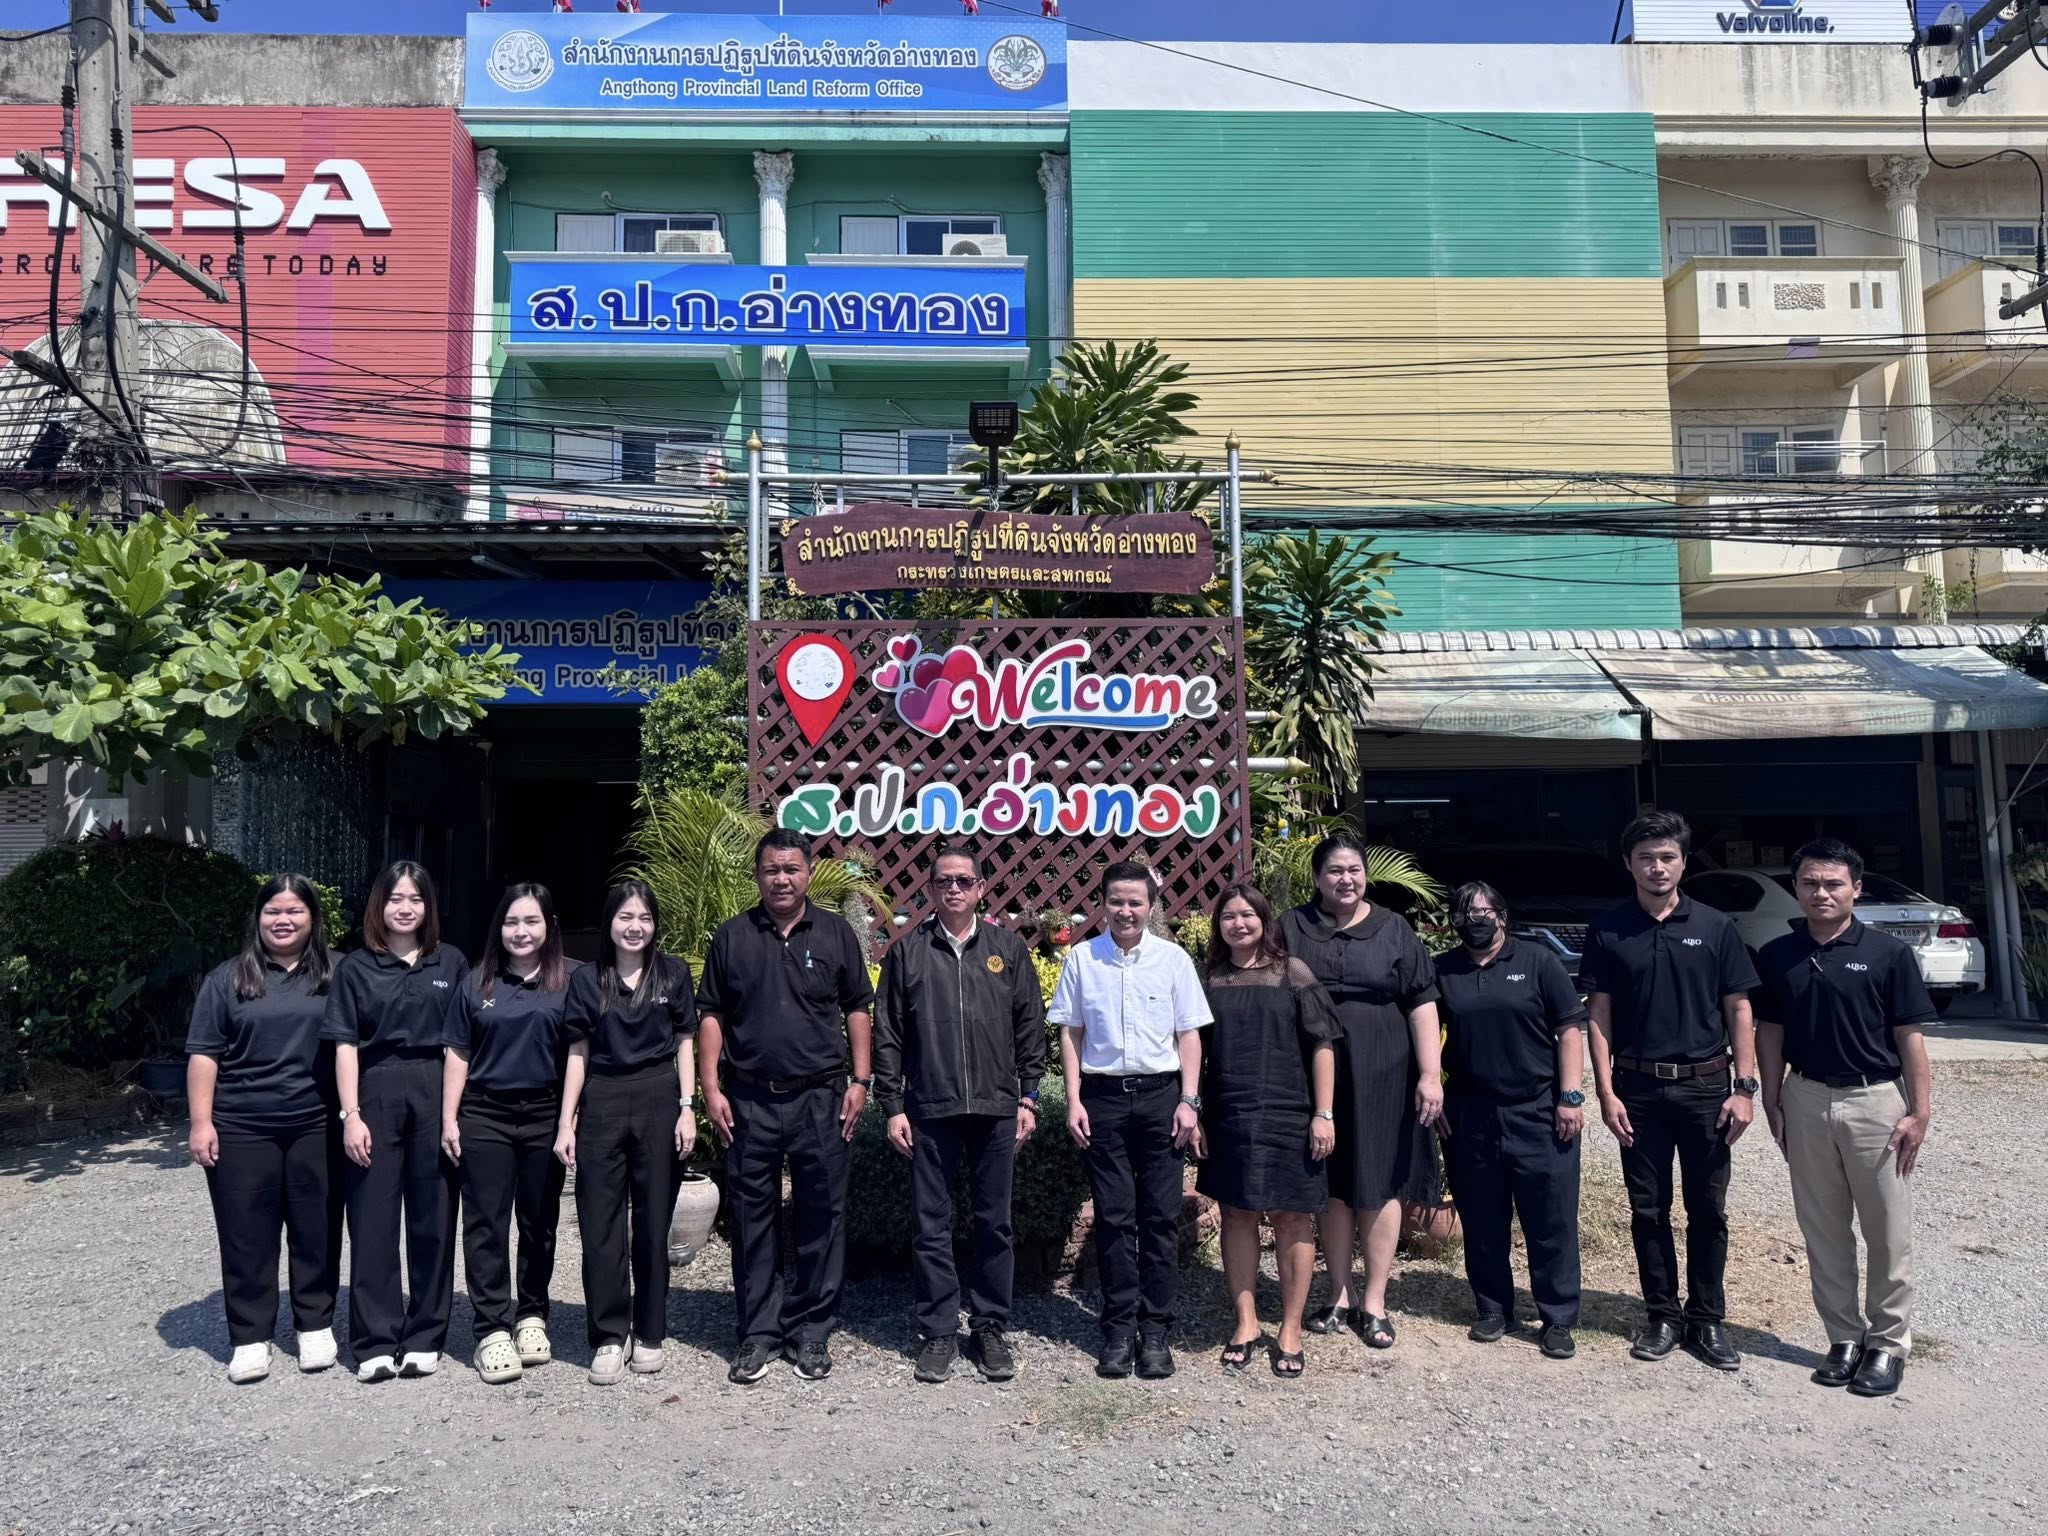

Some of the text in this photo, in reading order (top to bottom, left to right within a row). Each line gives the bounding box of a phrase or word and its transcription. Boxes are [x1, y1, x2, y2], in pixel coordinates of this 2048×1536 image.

[563, 35, 977, 77] สำนักงานการปฏิรูปที่ดินจังหวัดอ่างทอง
[602, 79, 922, 98] Angthong Provincial Land Reform Office
[263, 255, 387, 276] TODAY
[529, 274, 1009, 333] ส.ป.ก.อ่างทอง
[946, 640, 1216, 728] Welcome
[782, 756, 1218, 835] ส.ป.ก.อ่างทอง
